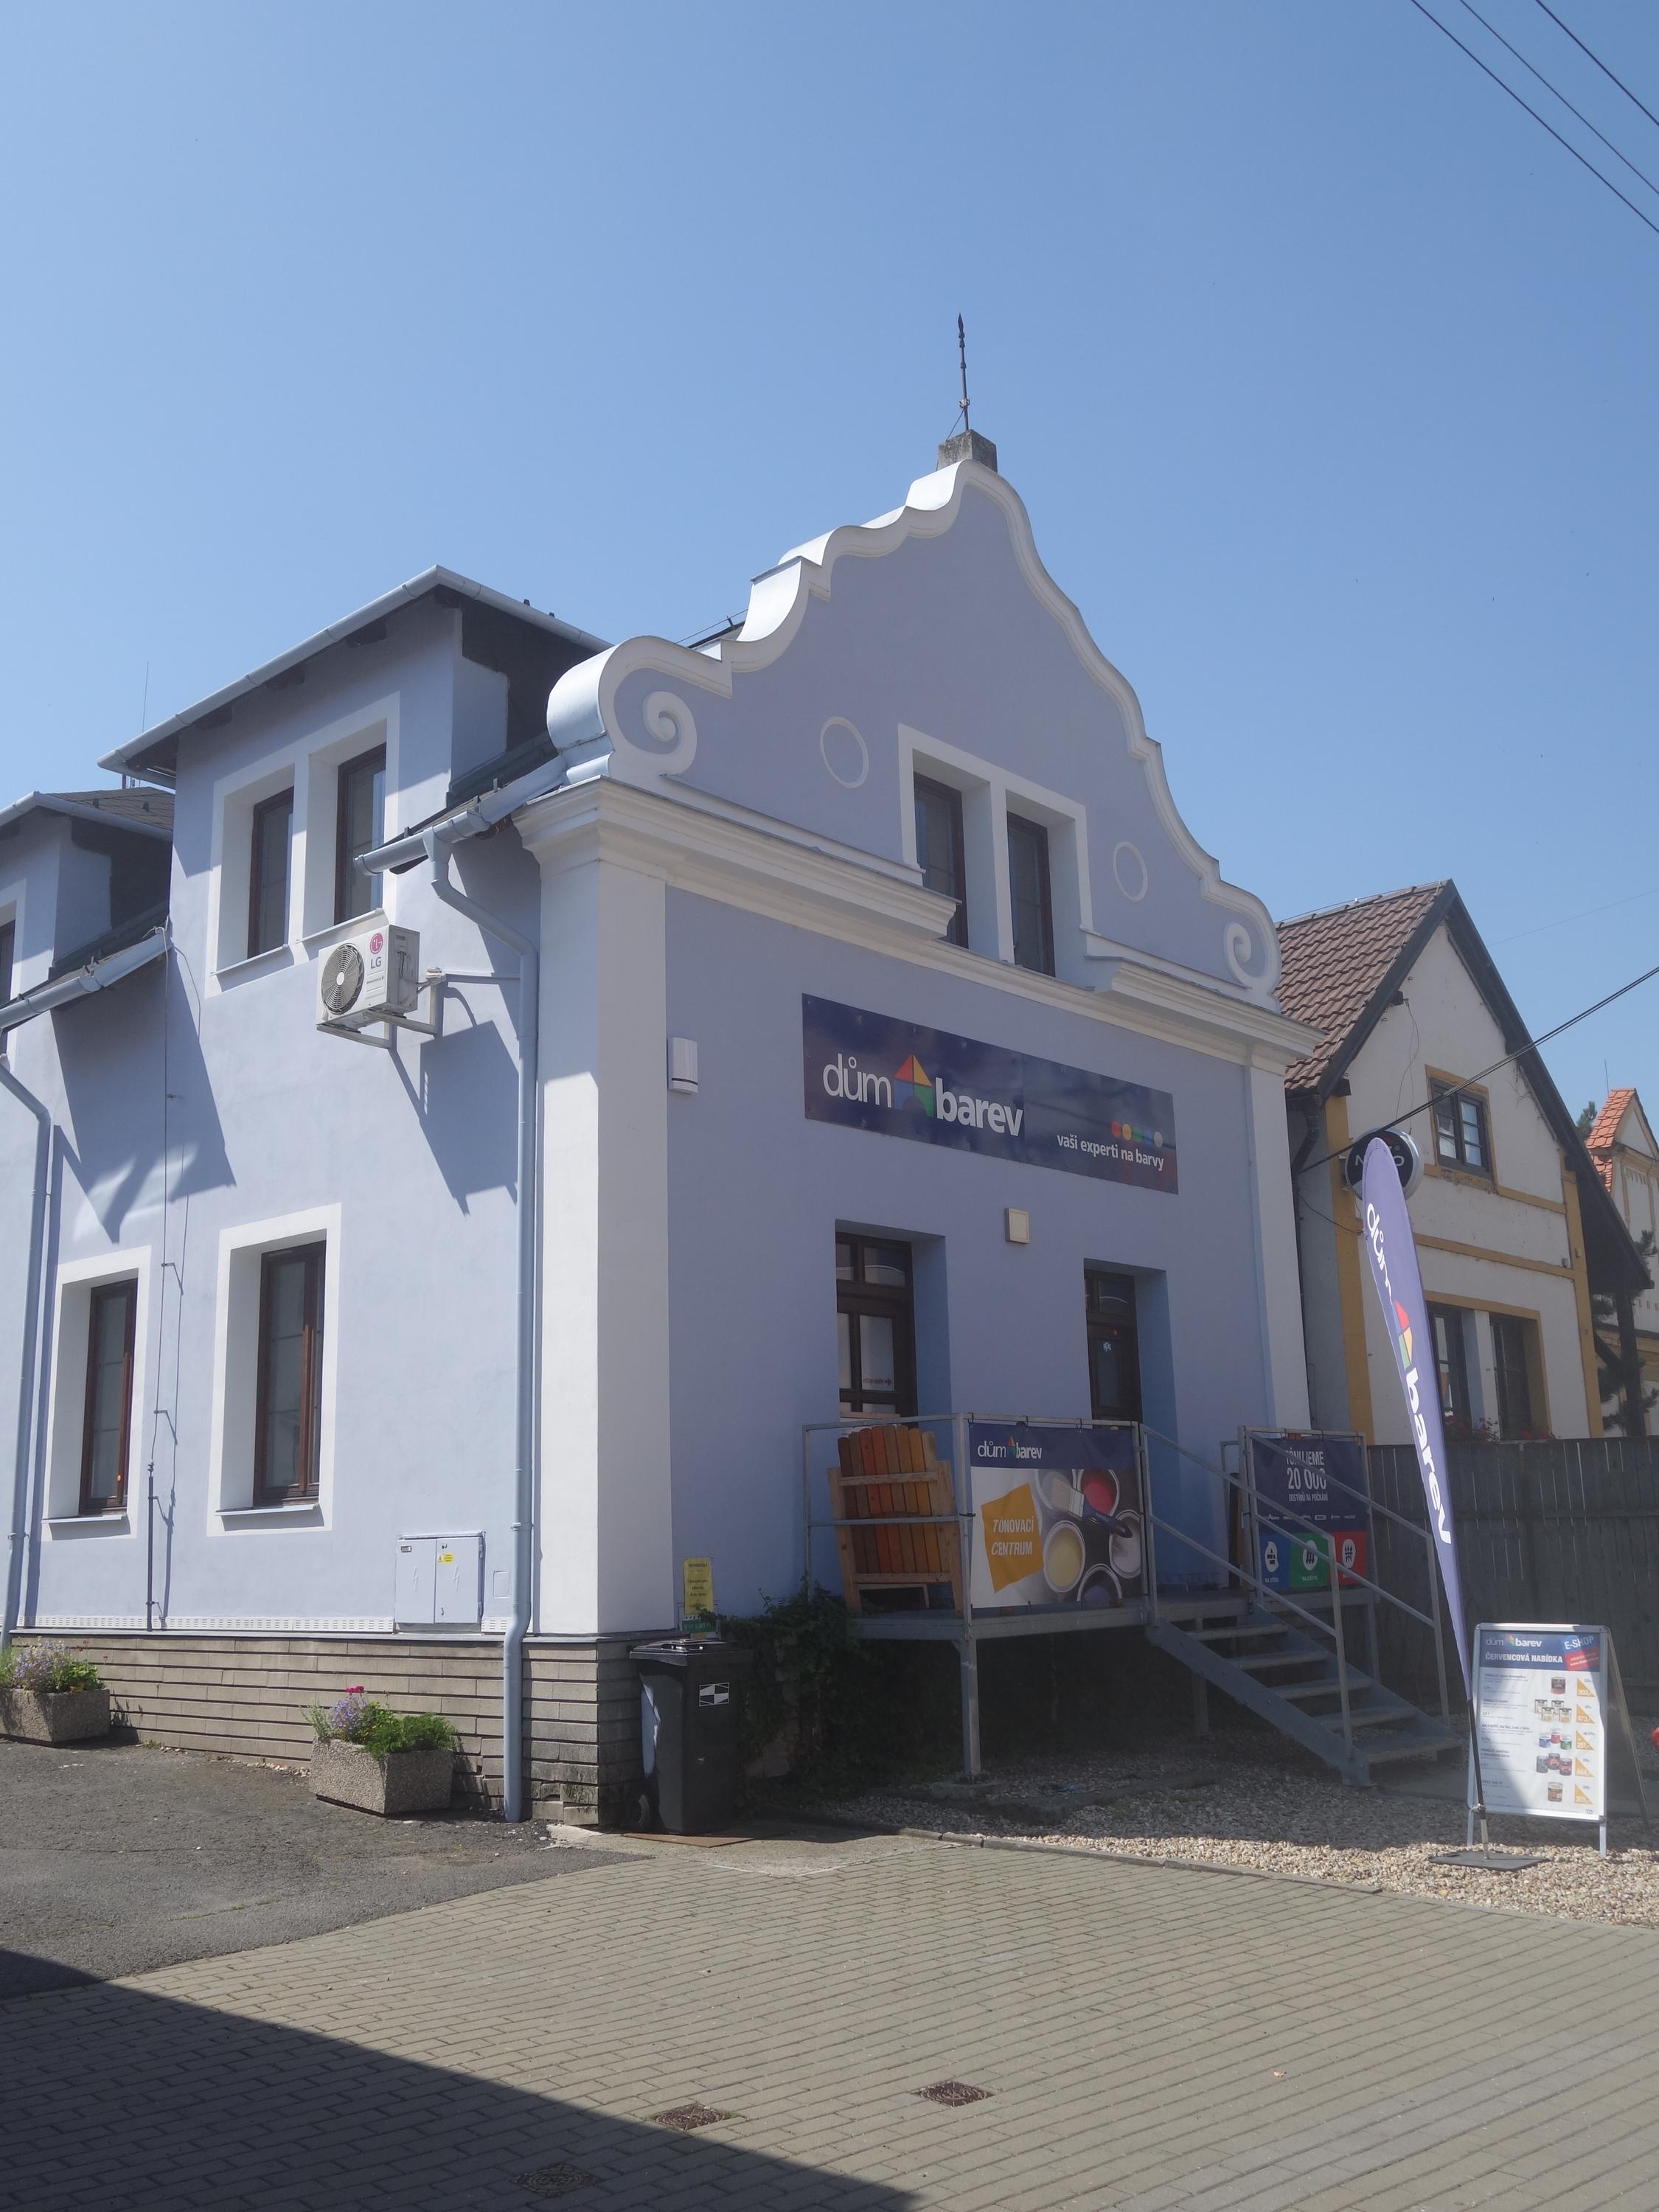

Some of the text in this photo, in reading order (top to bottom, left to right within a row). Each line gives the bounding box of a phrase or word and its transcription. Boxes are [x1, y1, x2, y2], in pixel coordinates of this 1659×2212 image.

[371, 956, 381, 969] LG
[822, 1052, 1024, 1137] dům barev
[1057, 1133, 1164, 1172] vaši experti na barvy
[977, 1440, 1042, 1460] dům barev
[1405, 1367, 1452, 1544] barev
[1287, 1467, 1301, 1490] 20
[992, 1515, 1034, 1534] TÓNOVACÍ
[991, 1540, 1033, 1556] CENTRUM
[1486, 1636, 1543, 1647] dům barev
[1564, 1635, 1594, 1650] E-SHOP
[1486, 1652, 1530, 1662] ČERVENCOVÁ
[1531, 1652, 1563, 1663] NABÍDKA
